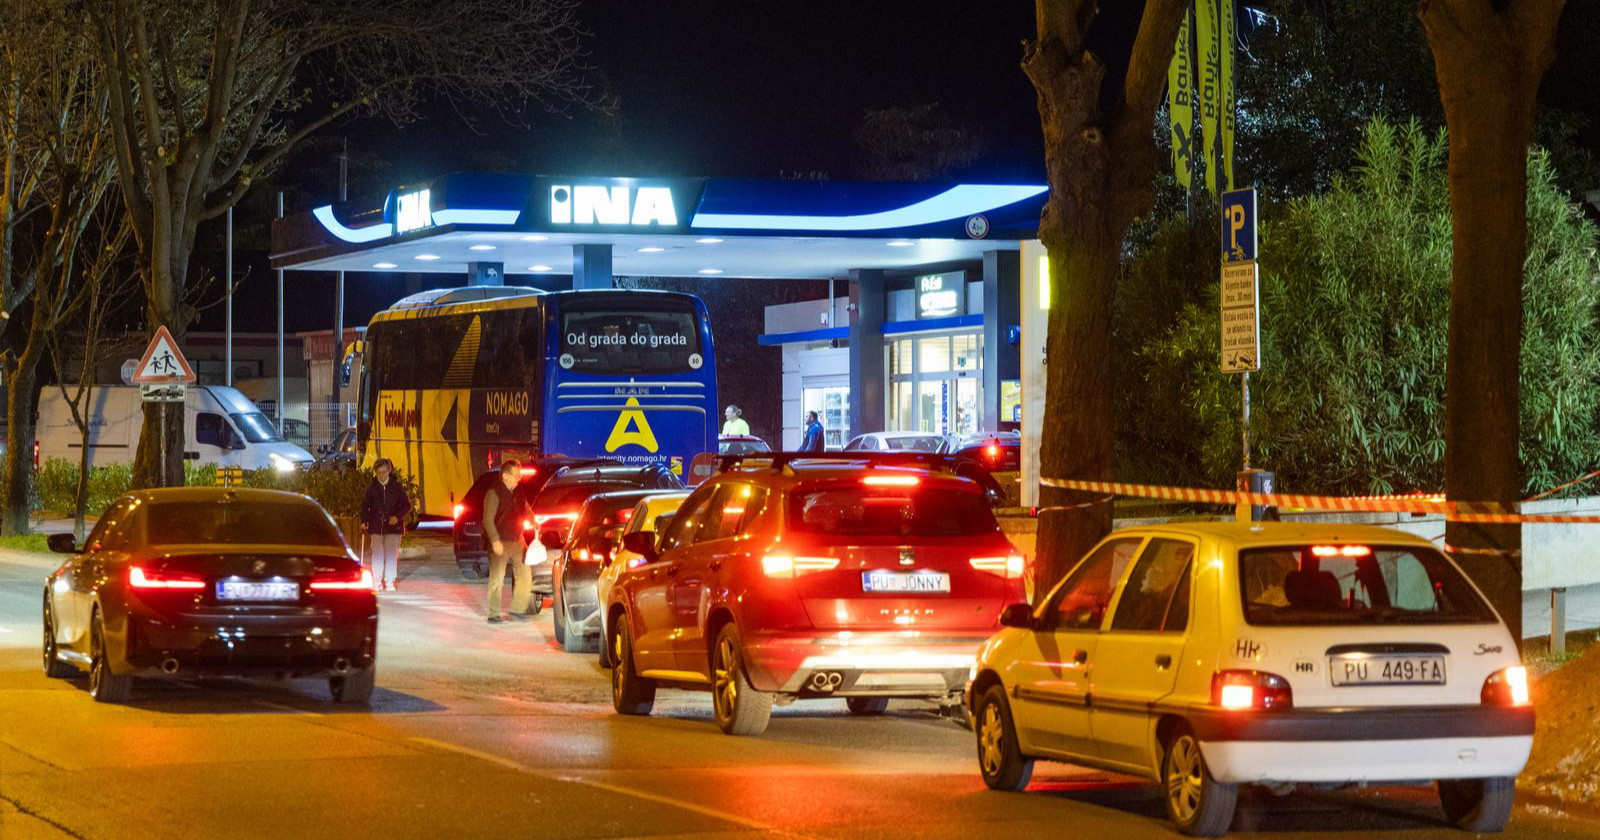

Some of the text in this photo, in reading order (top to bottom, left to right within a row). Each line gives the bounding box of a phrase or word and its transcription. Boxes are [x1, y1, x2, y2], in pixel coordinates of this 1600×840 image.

[1230, 203, 1246, 249] P
[567, 332, 687, 348] Od grada do grada
[486, 391, 529, 416] NOMAGO
[872, 575, 943, 589] PU JONNY
[1236, 639, 1260, 658] HR
[1295, 662, 1314, 673] HR
[1344, 664, 1369, 682] PU
